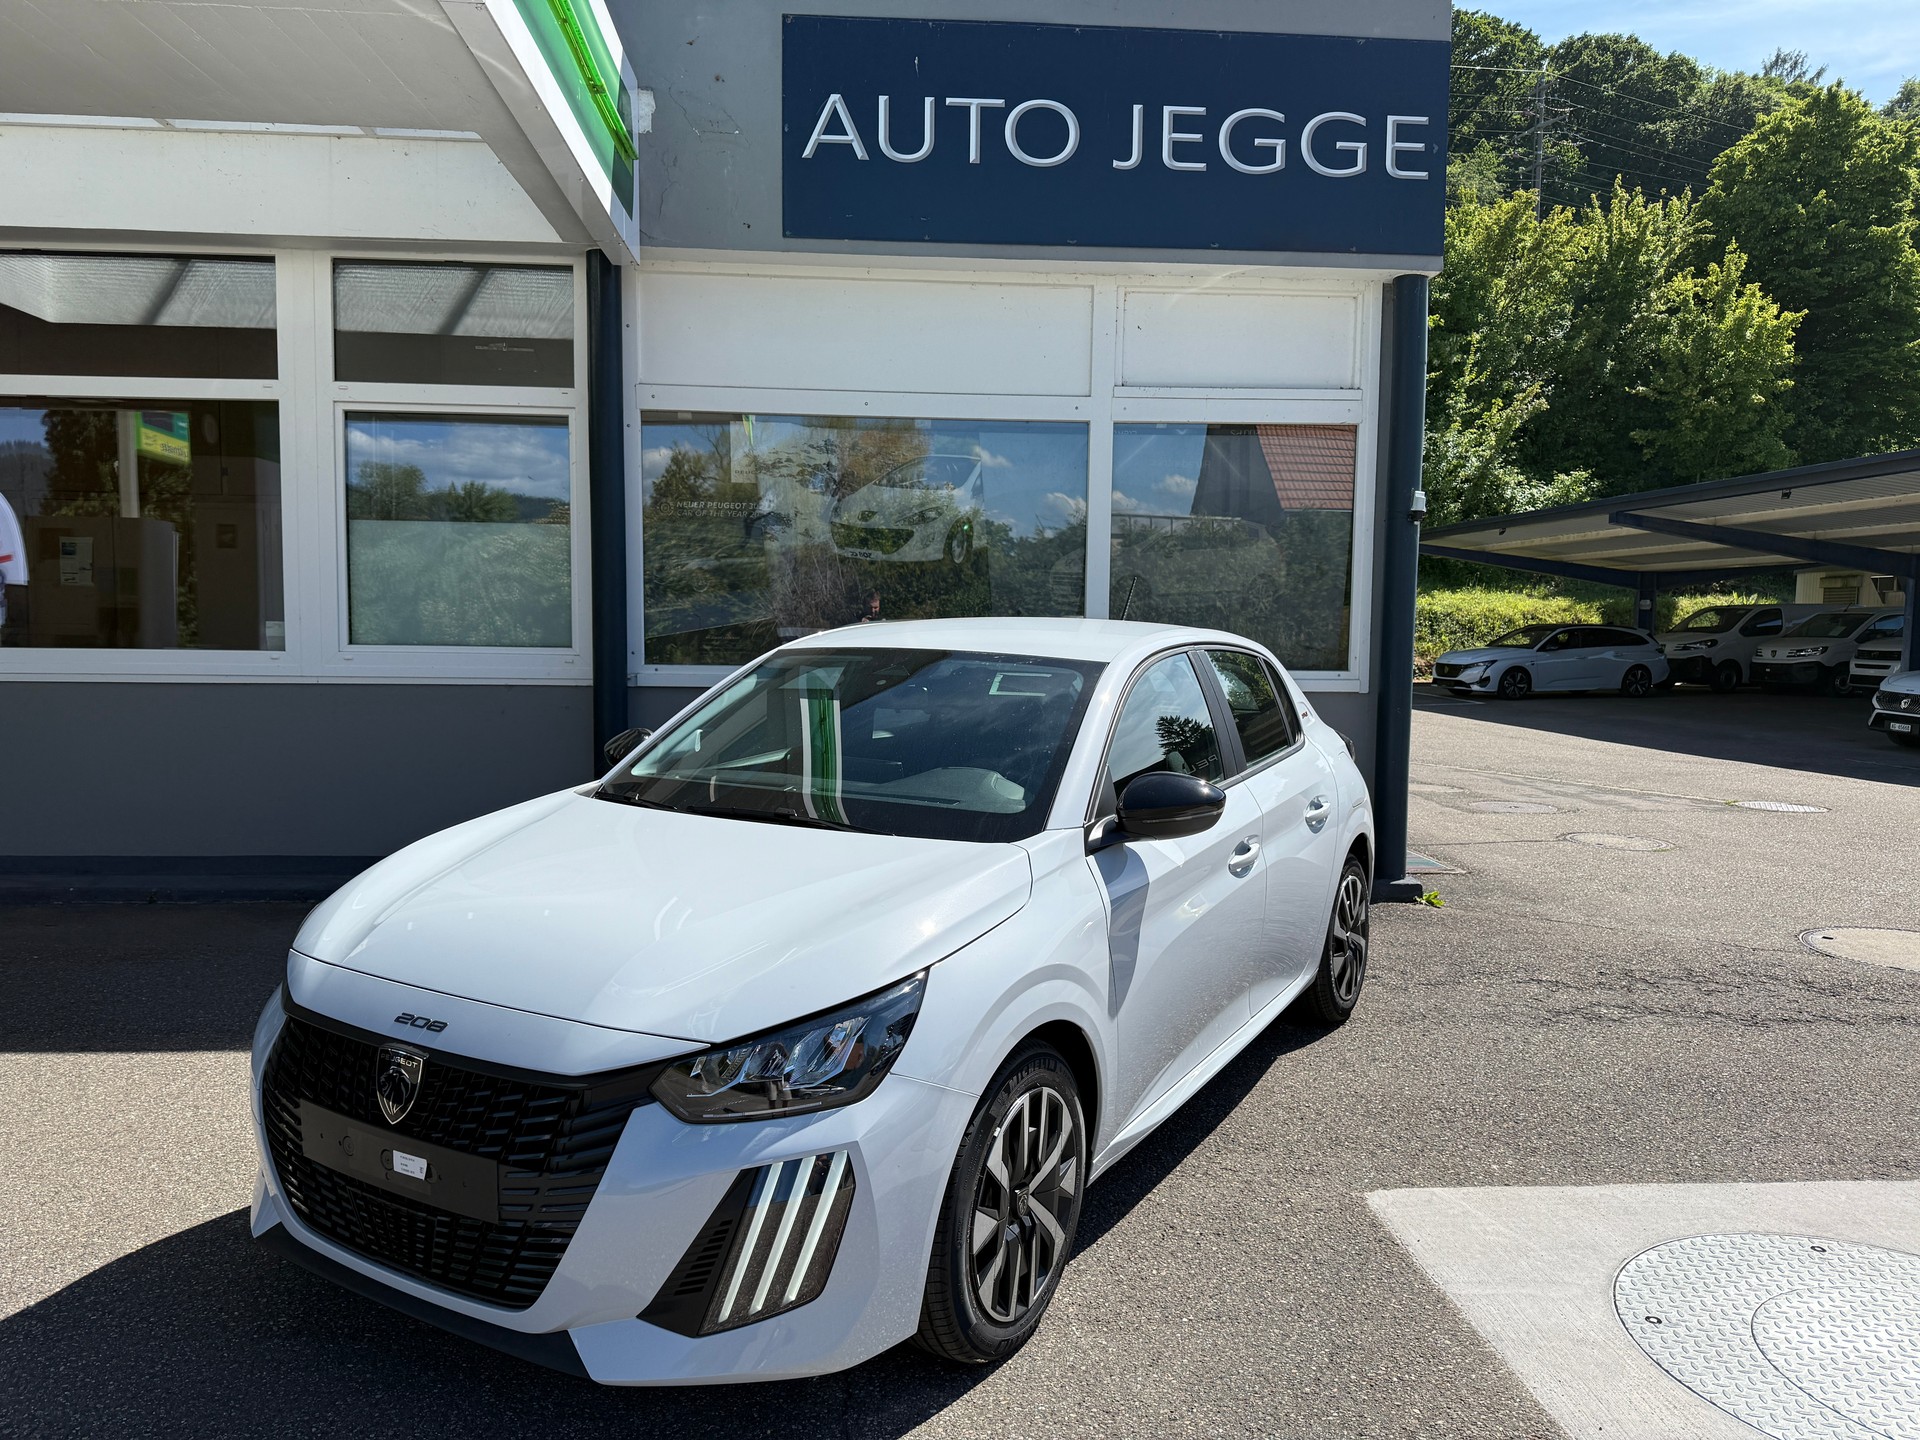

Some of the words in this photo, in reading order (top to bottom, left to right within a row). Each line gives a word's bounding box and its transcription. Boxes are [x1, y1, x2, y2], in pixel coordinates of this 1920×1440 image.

[802, 93, 1080, 167] AUTO
[1113, 103, 1429, 180] JEGGE
[676, 501, 705, 509] NEUER
[707, 501, 747, 509] PEUGEOT
[709, 510, 725, 518] THE
[394, 1012, 449, 1033] 208
[381, 1053, 418, 1069] PEUGEOT
[1009, 1058, 1058, 1092] MICHELIN
